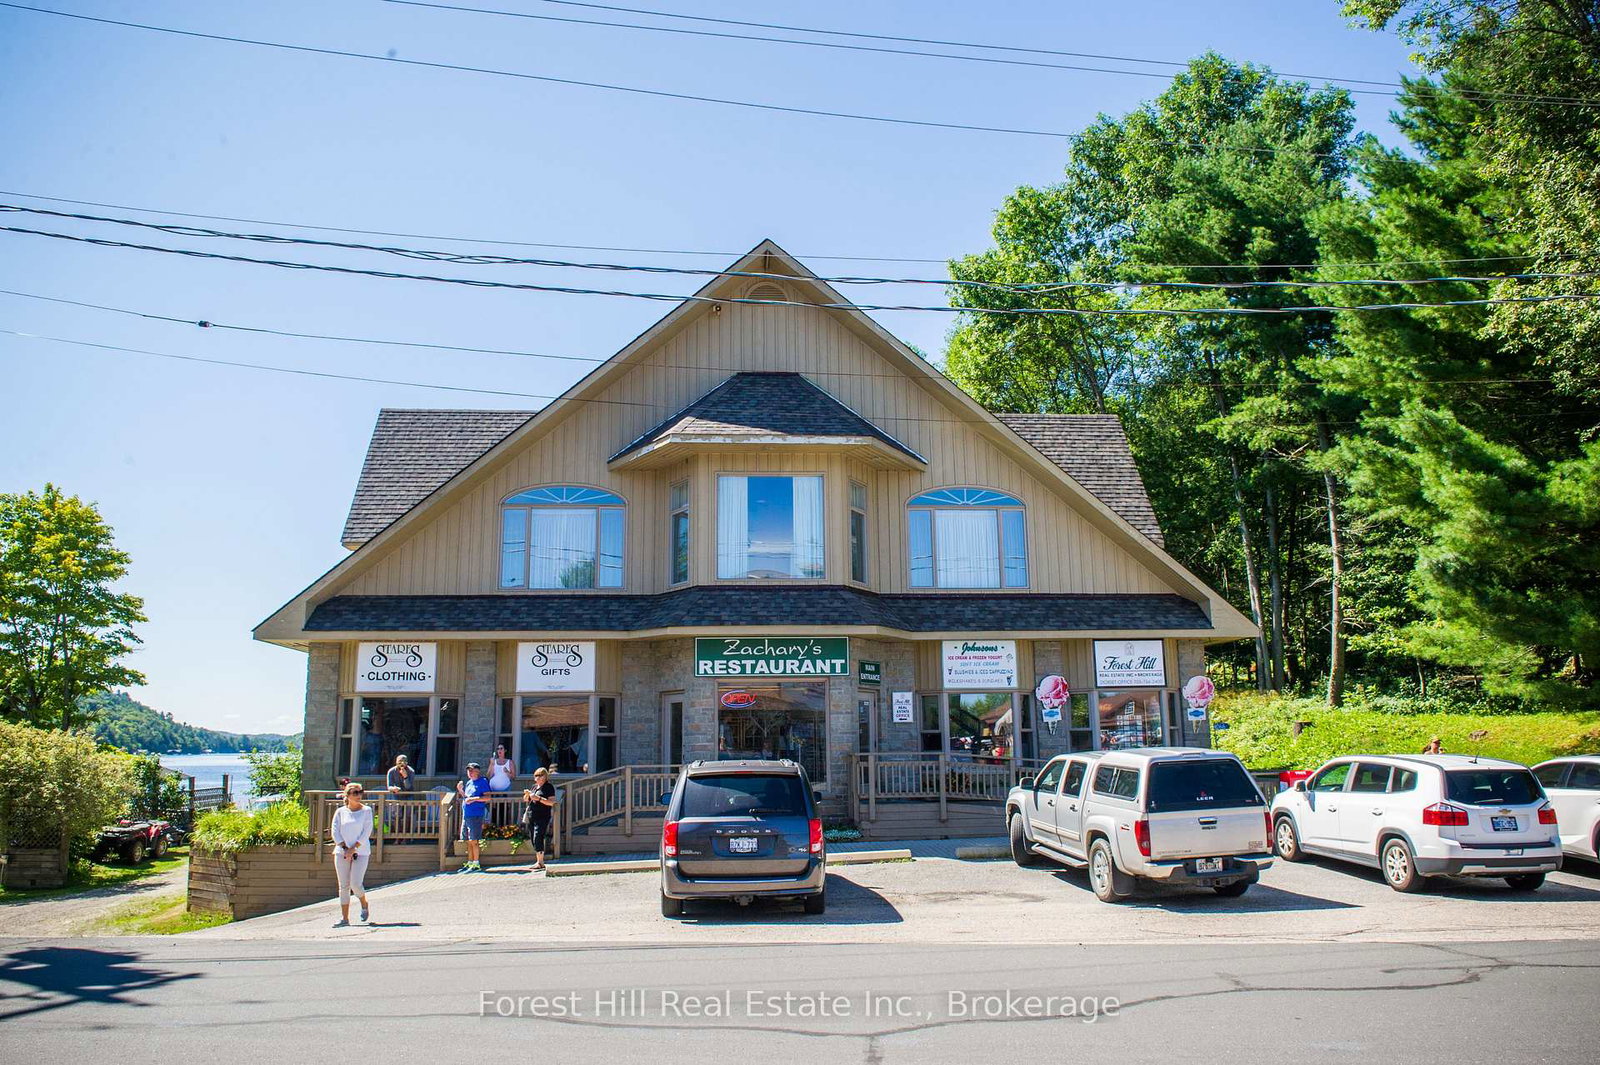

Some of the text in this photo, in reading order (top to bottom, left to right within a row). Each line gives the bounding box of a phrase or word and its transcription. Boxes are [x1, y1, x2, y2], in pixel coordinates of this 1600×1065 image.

[722, 639, 822, 659] Zachary's
[961, 642, 998, 655] Johnsons
[698, 659, 846, 675] RESTAURANT
[1103, 656, 1158, 670] Forest Hill
[367, 671, 426, 681] CLOTHING
[541, 668, 571, 676] GIFTS
[860, 673, 881, 681] ENTRANCE
